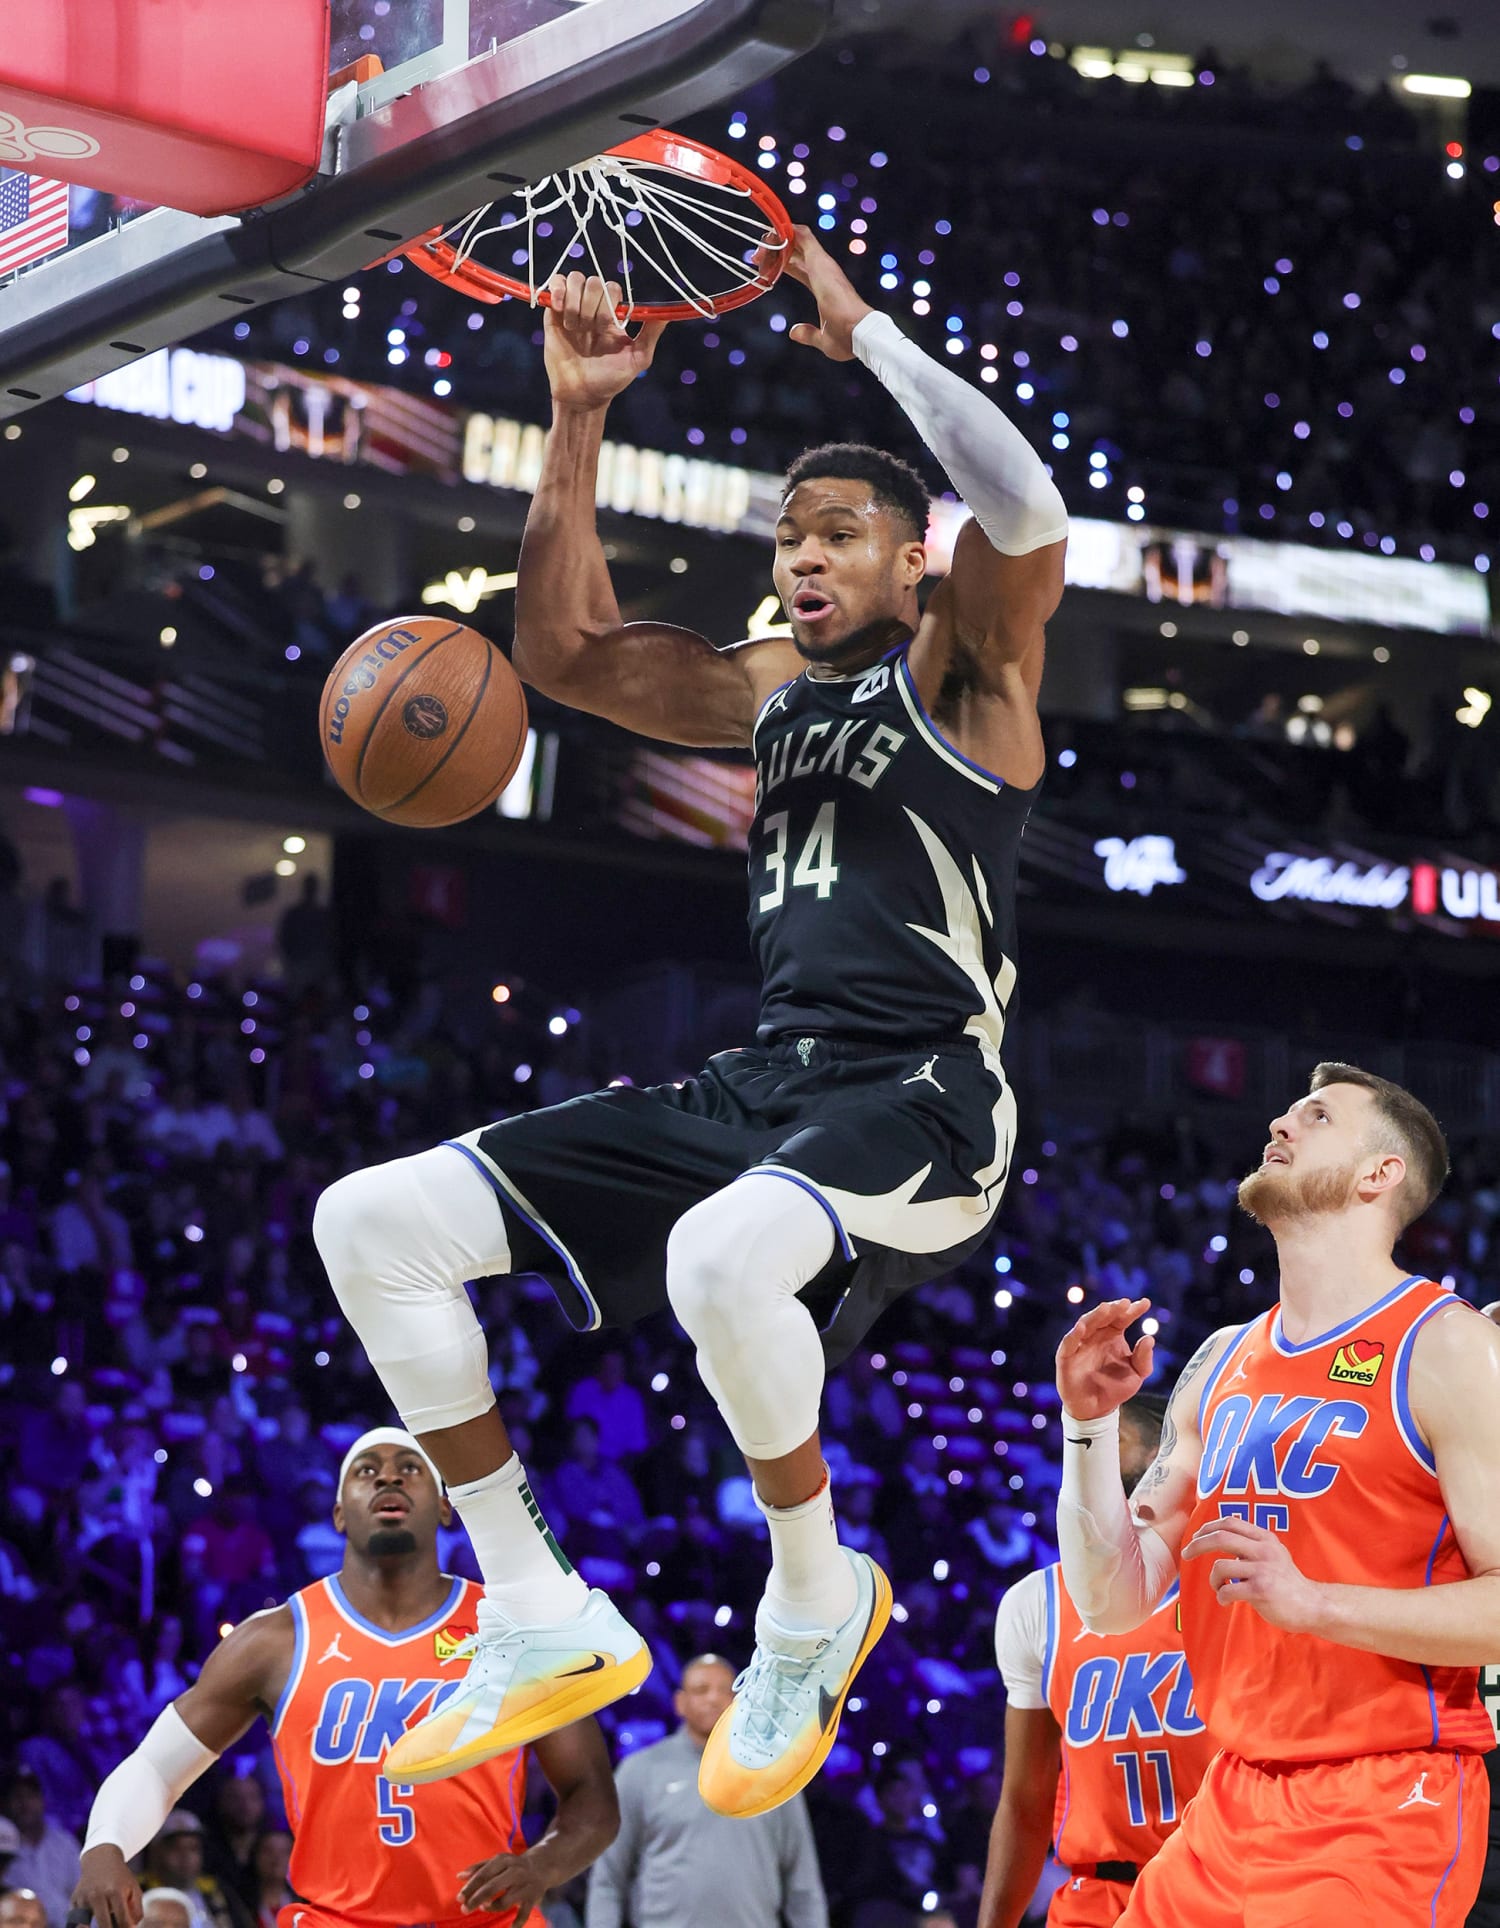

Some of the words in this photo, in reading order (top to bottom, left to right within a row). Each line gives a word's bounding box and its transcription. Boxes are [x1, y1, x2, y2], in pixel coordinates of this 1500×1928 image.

[329, 628, 423, 746] Wilson
[757, 800, 840, 914] 34
[1197, 1393, 1369, 1500] OKC
[311, 1677, 463, 1766] OK
[375, 1774, 416, 1847] 5
[1113, 1750, 1177, 1827] 11
